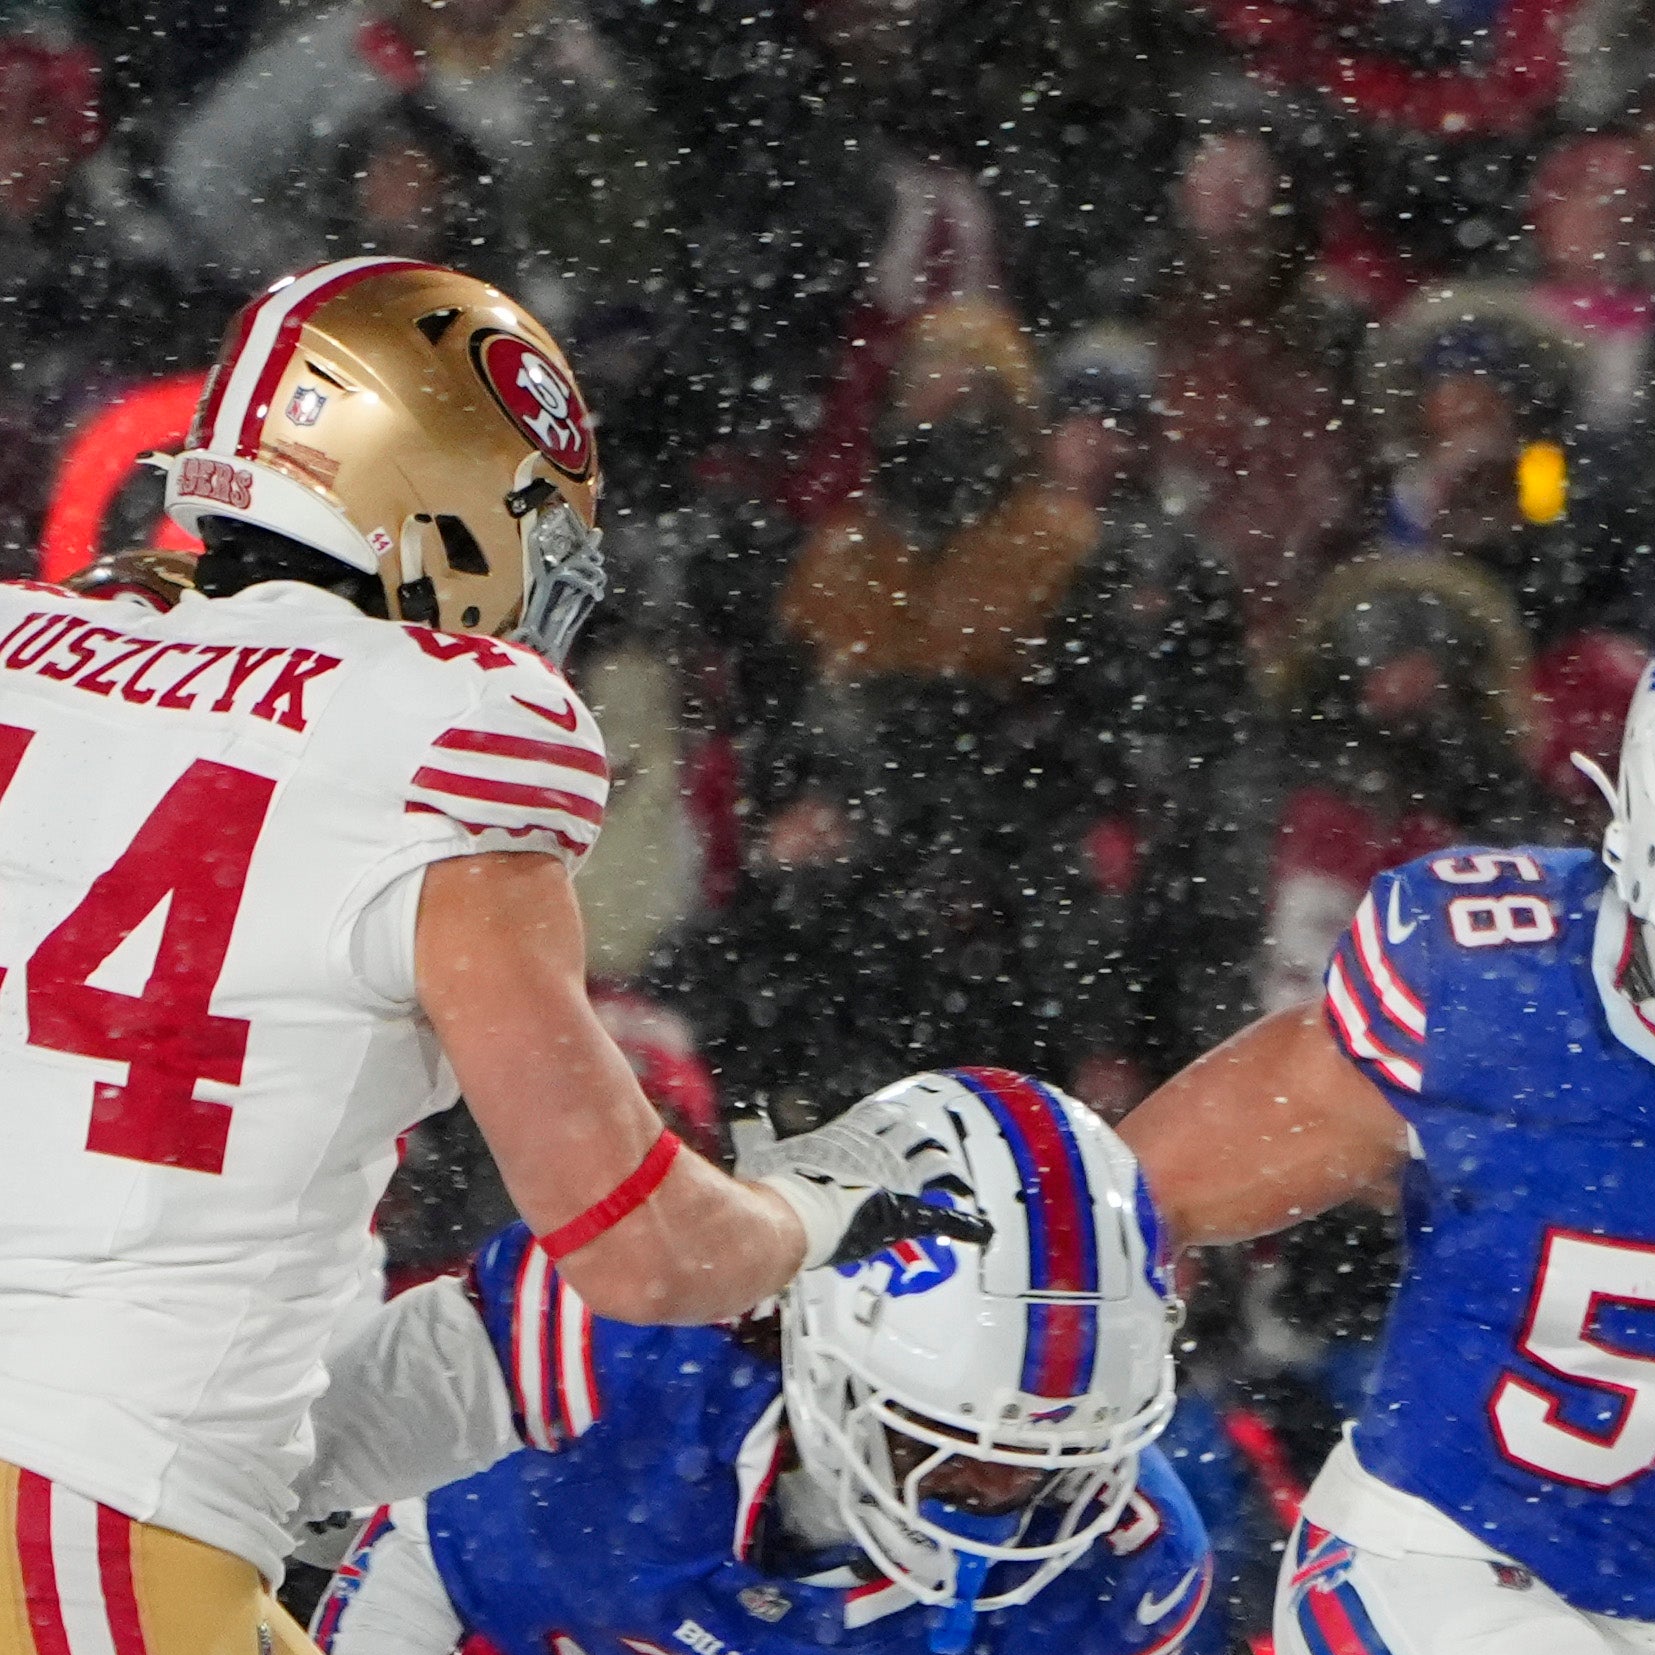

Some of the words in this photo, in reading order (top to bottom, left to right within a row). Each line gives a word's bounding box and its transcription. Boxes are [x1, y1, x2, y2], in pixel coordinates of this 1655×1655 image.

[177, 458, 253, 510] 9ERS
[0, 611, 344, 733] USZCZYK
[0, 724, 278, 1176] 4
[1430, 852, 1561, 950] 58
